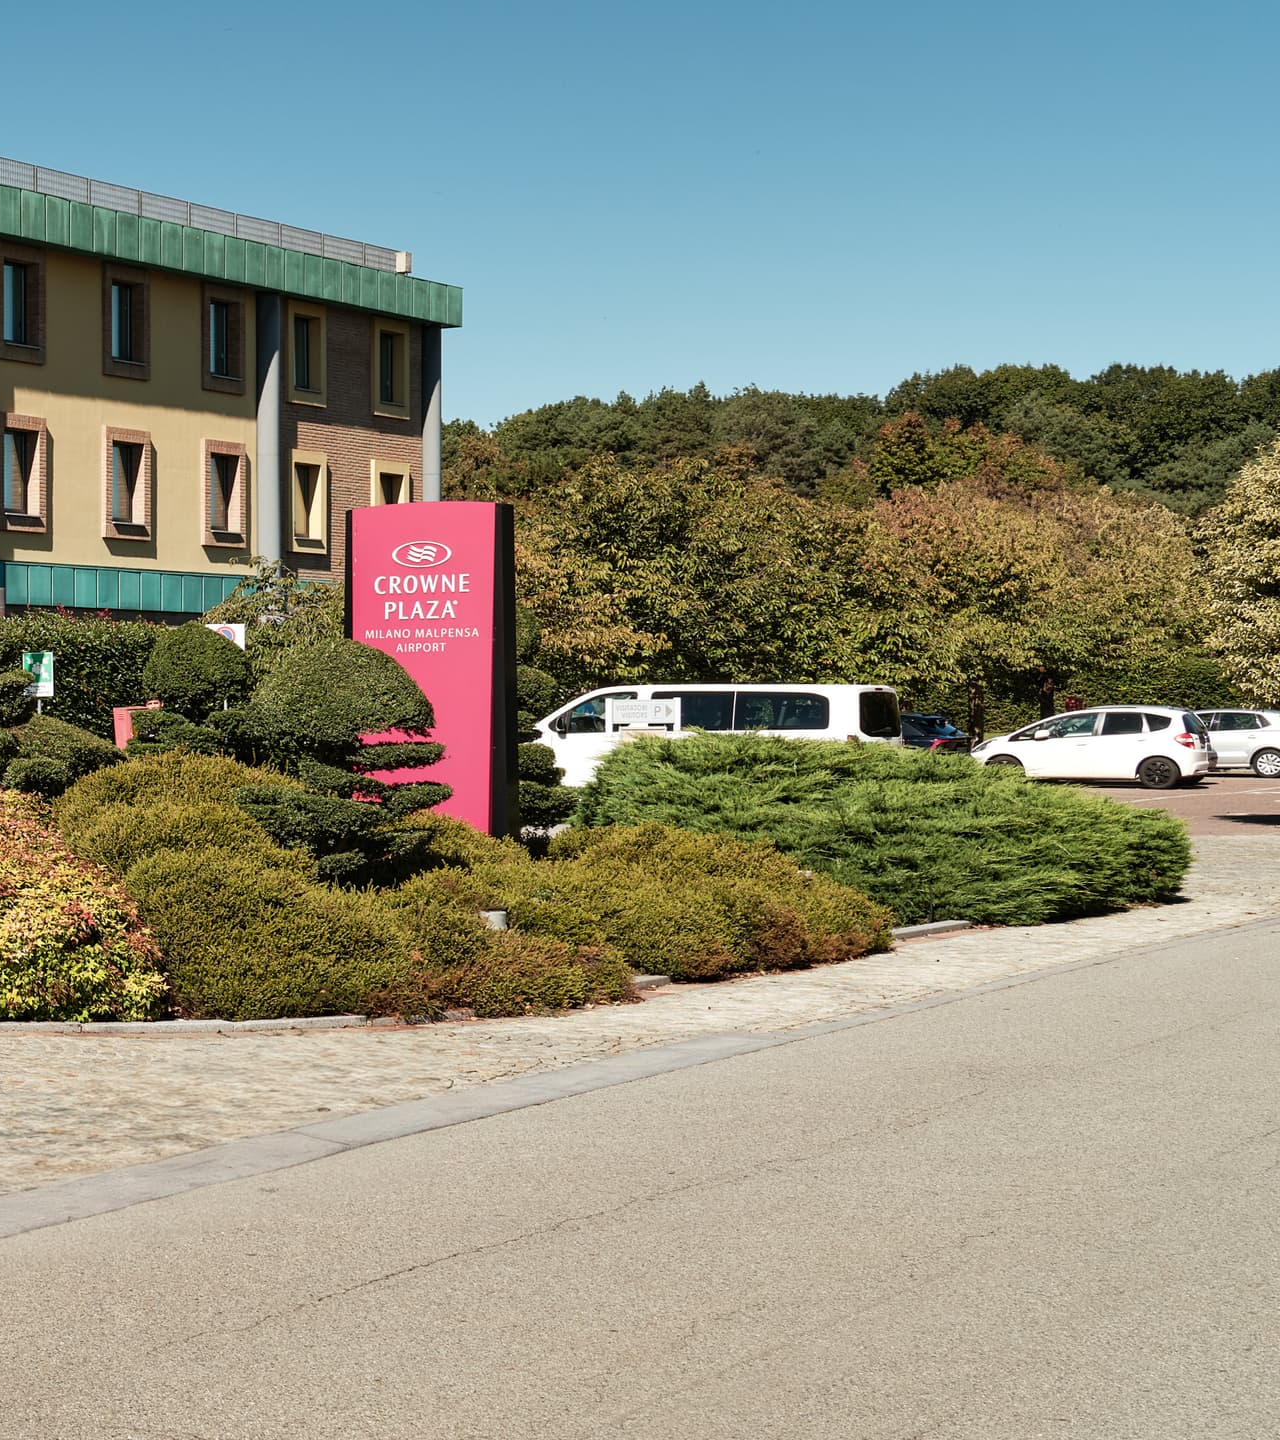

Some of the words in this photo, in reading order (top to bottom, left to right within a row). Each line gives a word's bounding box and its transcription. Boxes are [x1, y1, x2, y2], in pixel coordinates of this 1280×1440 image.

[373, 573, 470, 595] CROWNE
[384, 600, 457, 620] PLAZA
[365, 628, 411, 639] MILANO
[415, 627, 480, 638] MALPENSA
[396, 642, 447, 653] AIRPORT
